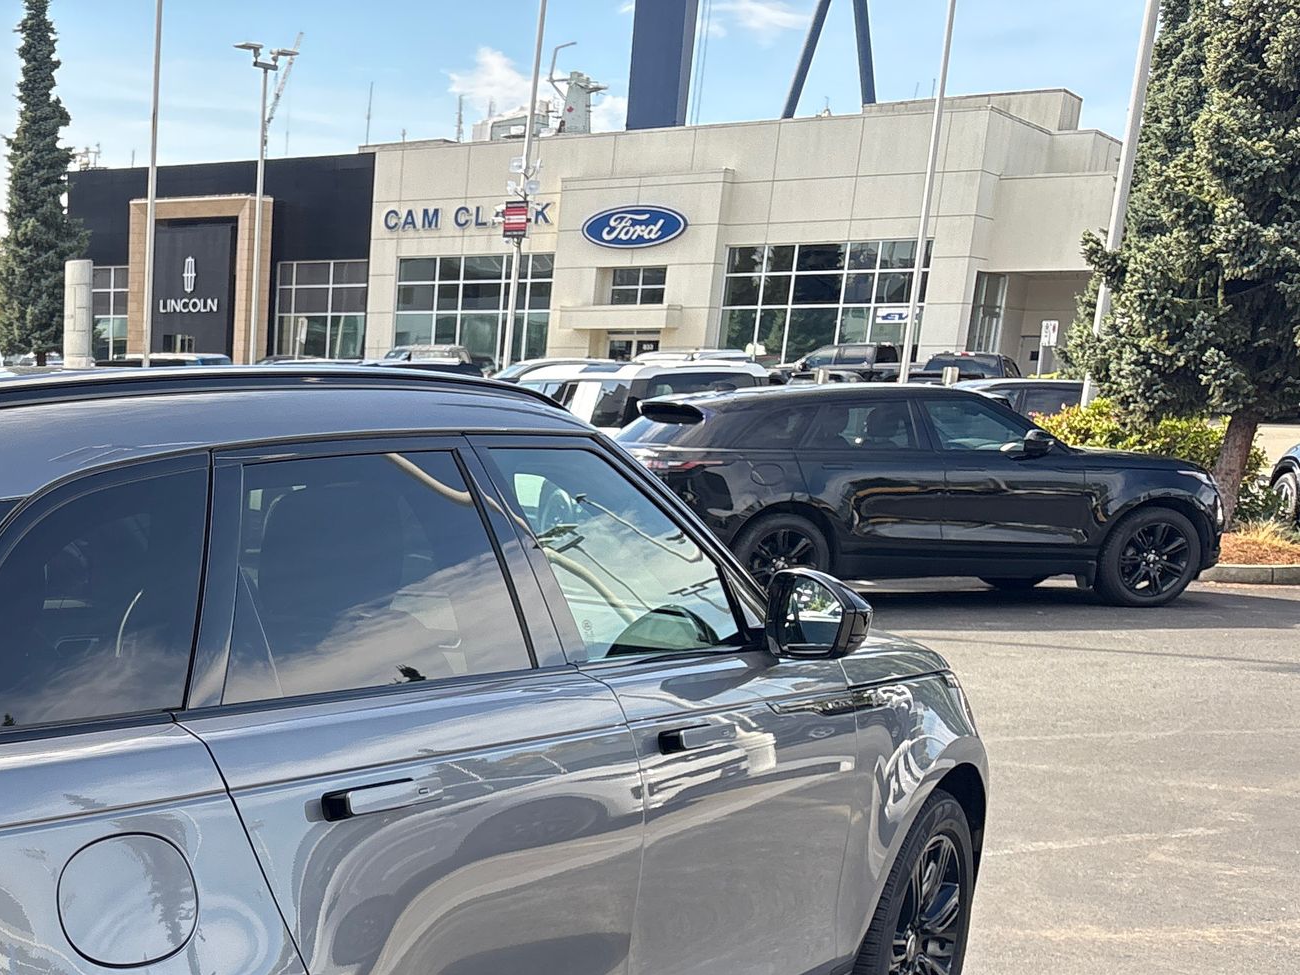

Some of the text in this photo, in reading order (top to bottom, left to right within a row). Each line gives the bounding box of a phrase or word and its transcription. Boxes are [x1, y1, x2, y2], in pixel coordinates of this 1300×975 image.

[384, 208, 440, 231] CAM
[454, 202, 553, 228] CLK
[602, 213, 665, 241] Ford
[159, 298, 218, 313] LINCOLN
